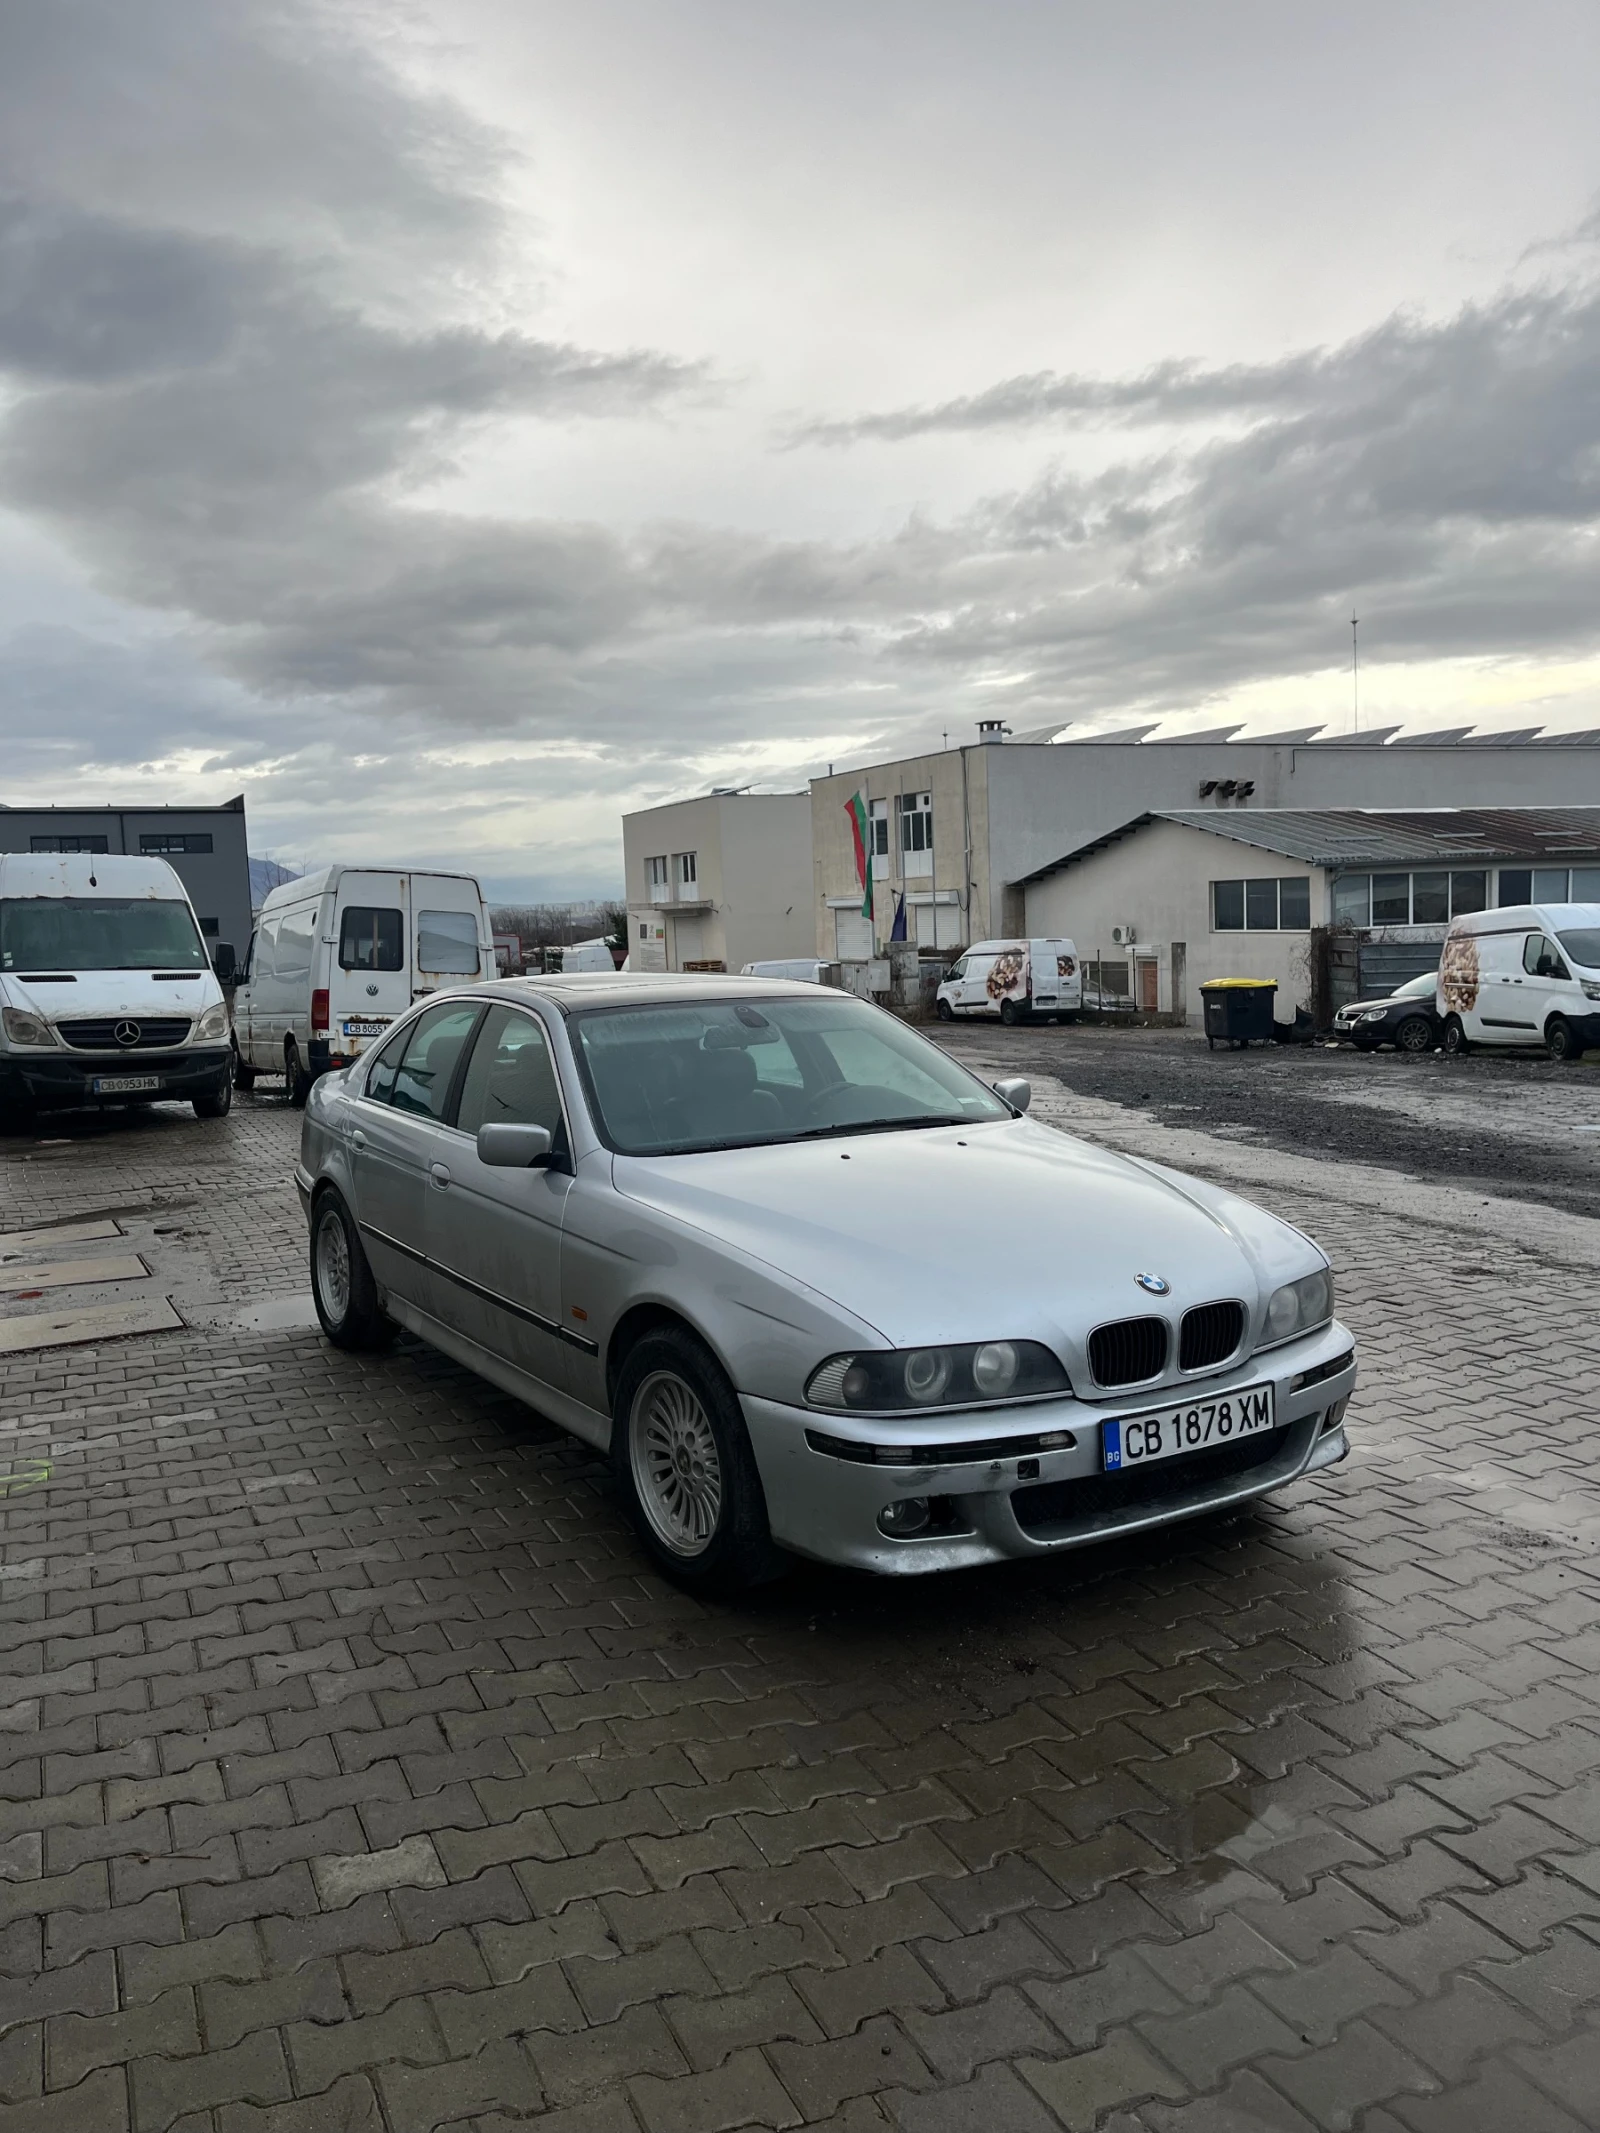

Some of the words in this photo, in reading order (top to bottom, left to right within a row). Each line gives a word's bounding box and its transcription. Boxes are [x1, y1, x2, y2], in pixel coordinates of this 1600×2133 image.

[350, 1024, 361, 1033] CB
[362, 1024, 383, 1034] 8055
[101, 1081, 115, 1091] CB
[116, 1079, 142, 1090] 0953
[143, 1078, 157, 1088] HK
[1107, 1450, 1120, 1464] BG
[1125, 1419, 1163, 1459] CB
[1172, 1402, 1233, 1449] 1878
[1237, 1391, 1269, 1433] XM
